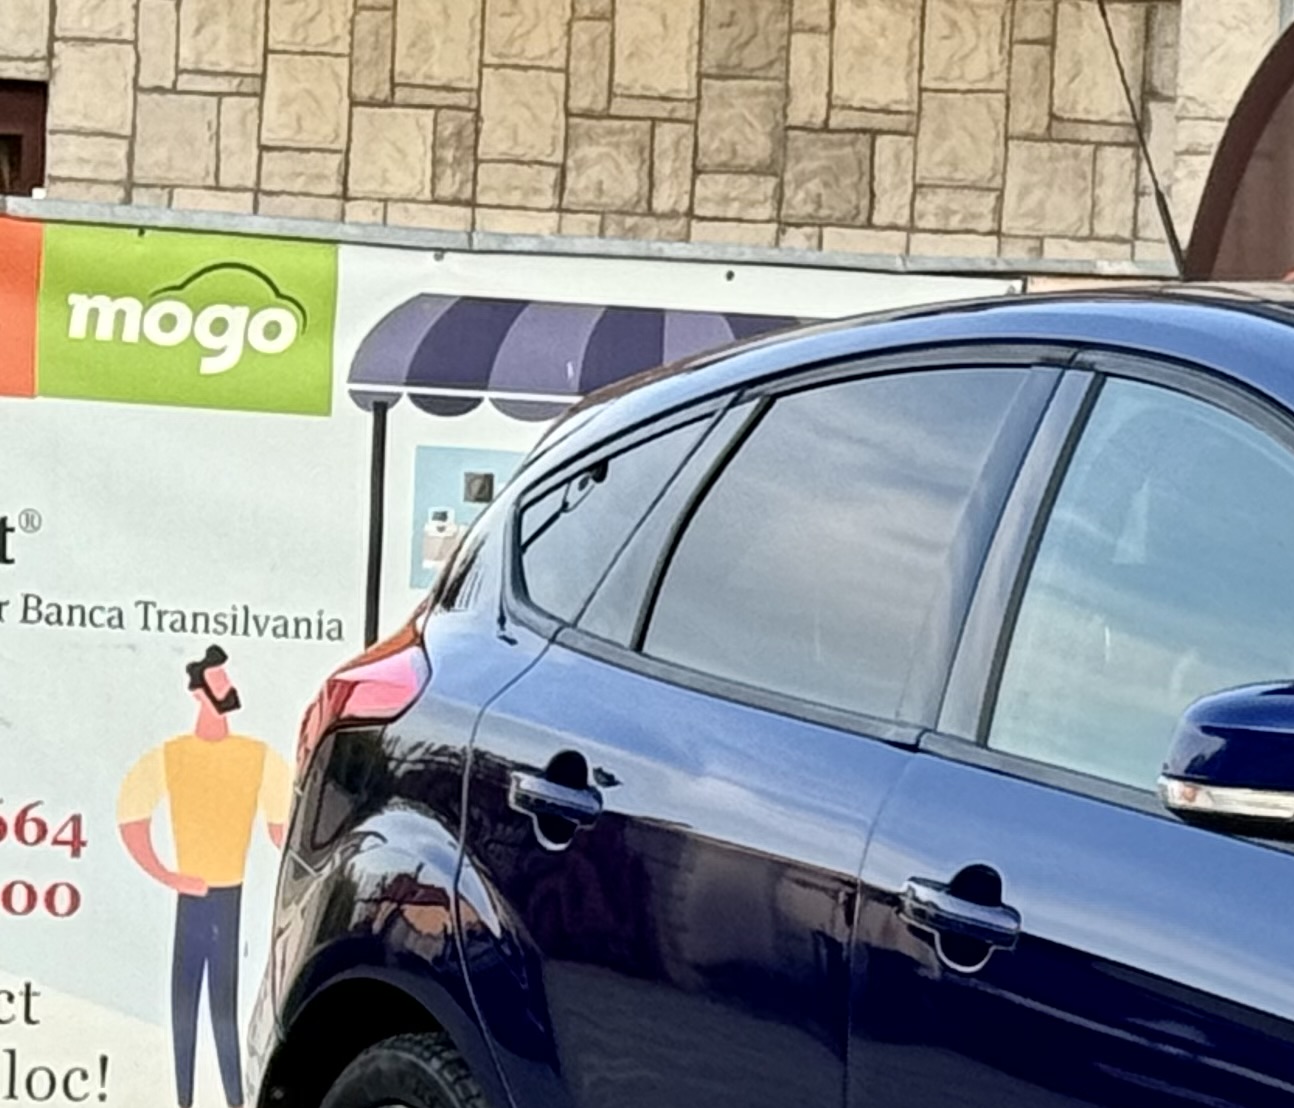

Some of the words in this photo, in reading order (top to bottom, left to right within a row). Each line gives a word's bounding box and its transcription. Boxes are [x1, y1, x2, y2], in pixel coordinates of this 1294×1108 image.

[67, 290, 298, 374] mogo
[20, 592, 126, 630] Banca
[134, 599, 346, 642] Transilvania
[4, 1048, 108, 1103] loc!
